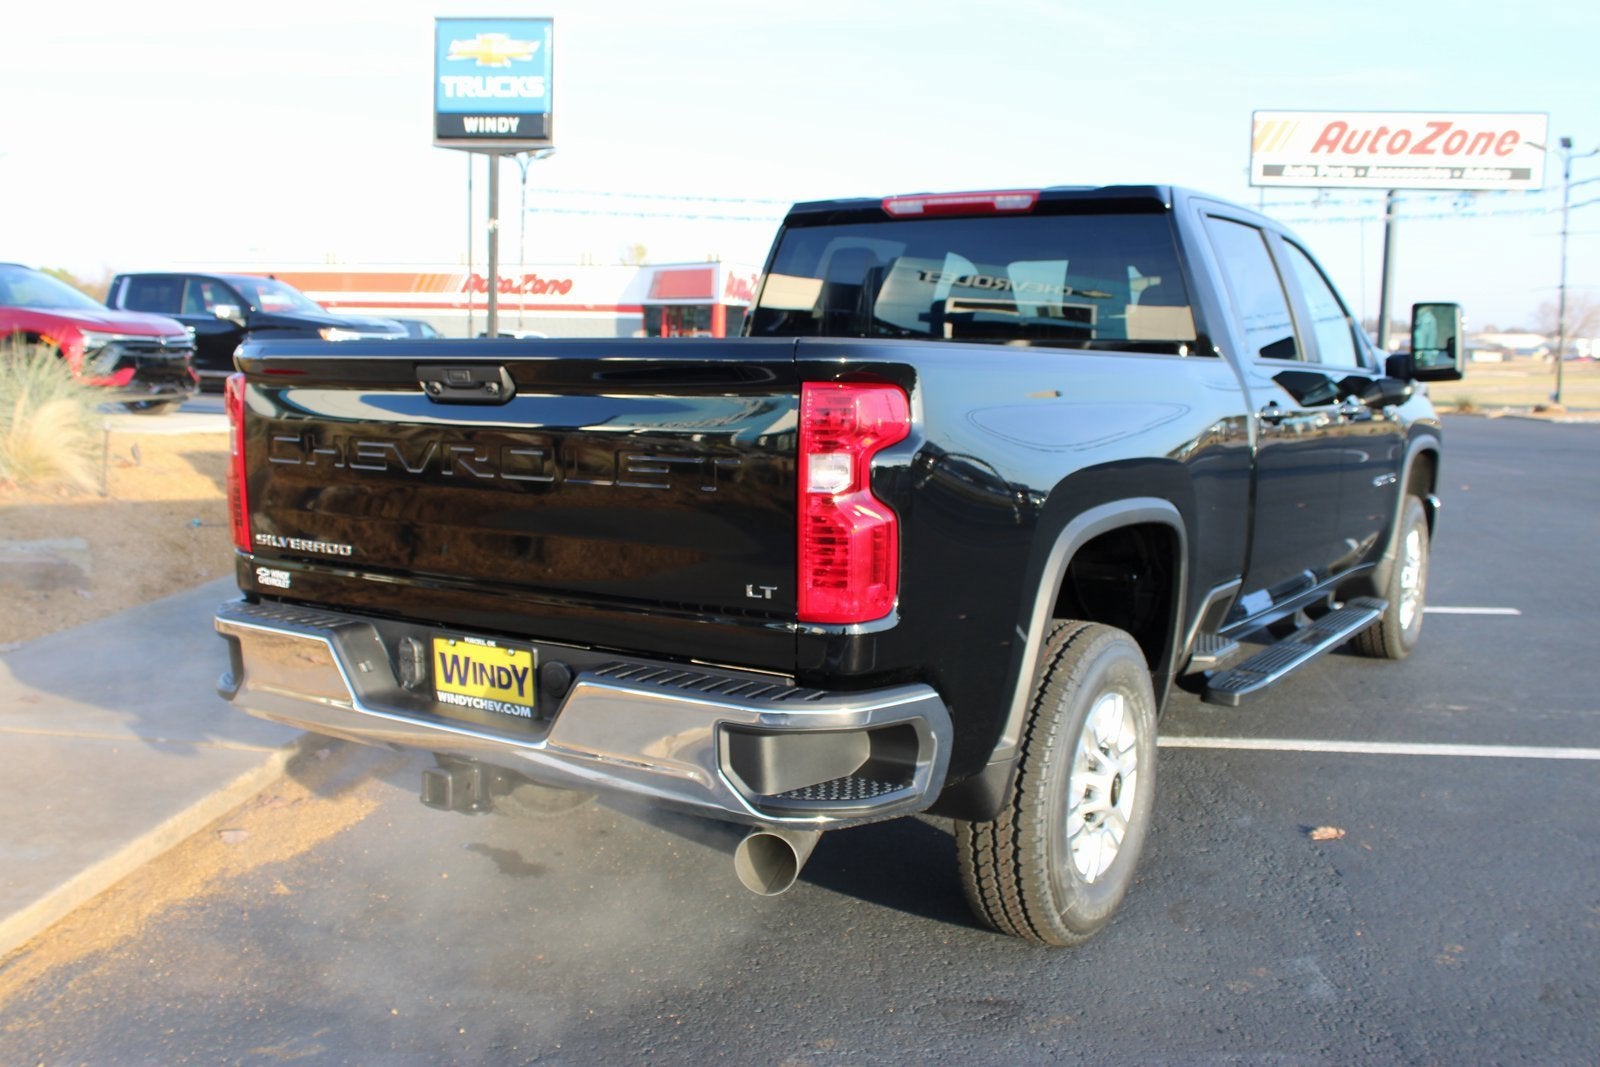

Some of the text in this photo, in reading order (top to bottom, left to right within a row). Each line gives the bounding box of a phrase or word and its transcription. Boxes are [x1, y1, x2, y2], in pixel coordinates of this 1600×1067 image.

[440, 75, 545, 98] TRUCKS
[463, 116, 520, 133] WINDY
[1310, 120, 1521, 157] AutoZone
[268, 433, 742, 493] CHEVROLET
[256, 533, 353, 556] SILVERADO
[746, 584, 778, 599] LT
[439, 652, 530, 698] WINDY
[437, 690, 532, 718] WINDYCHEV.COM
